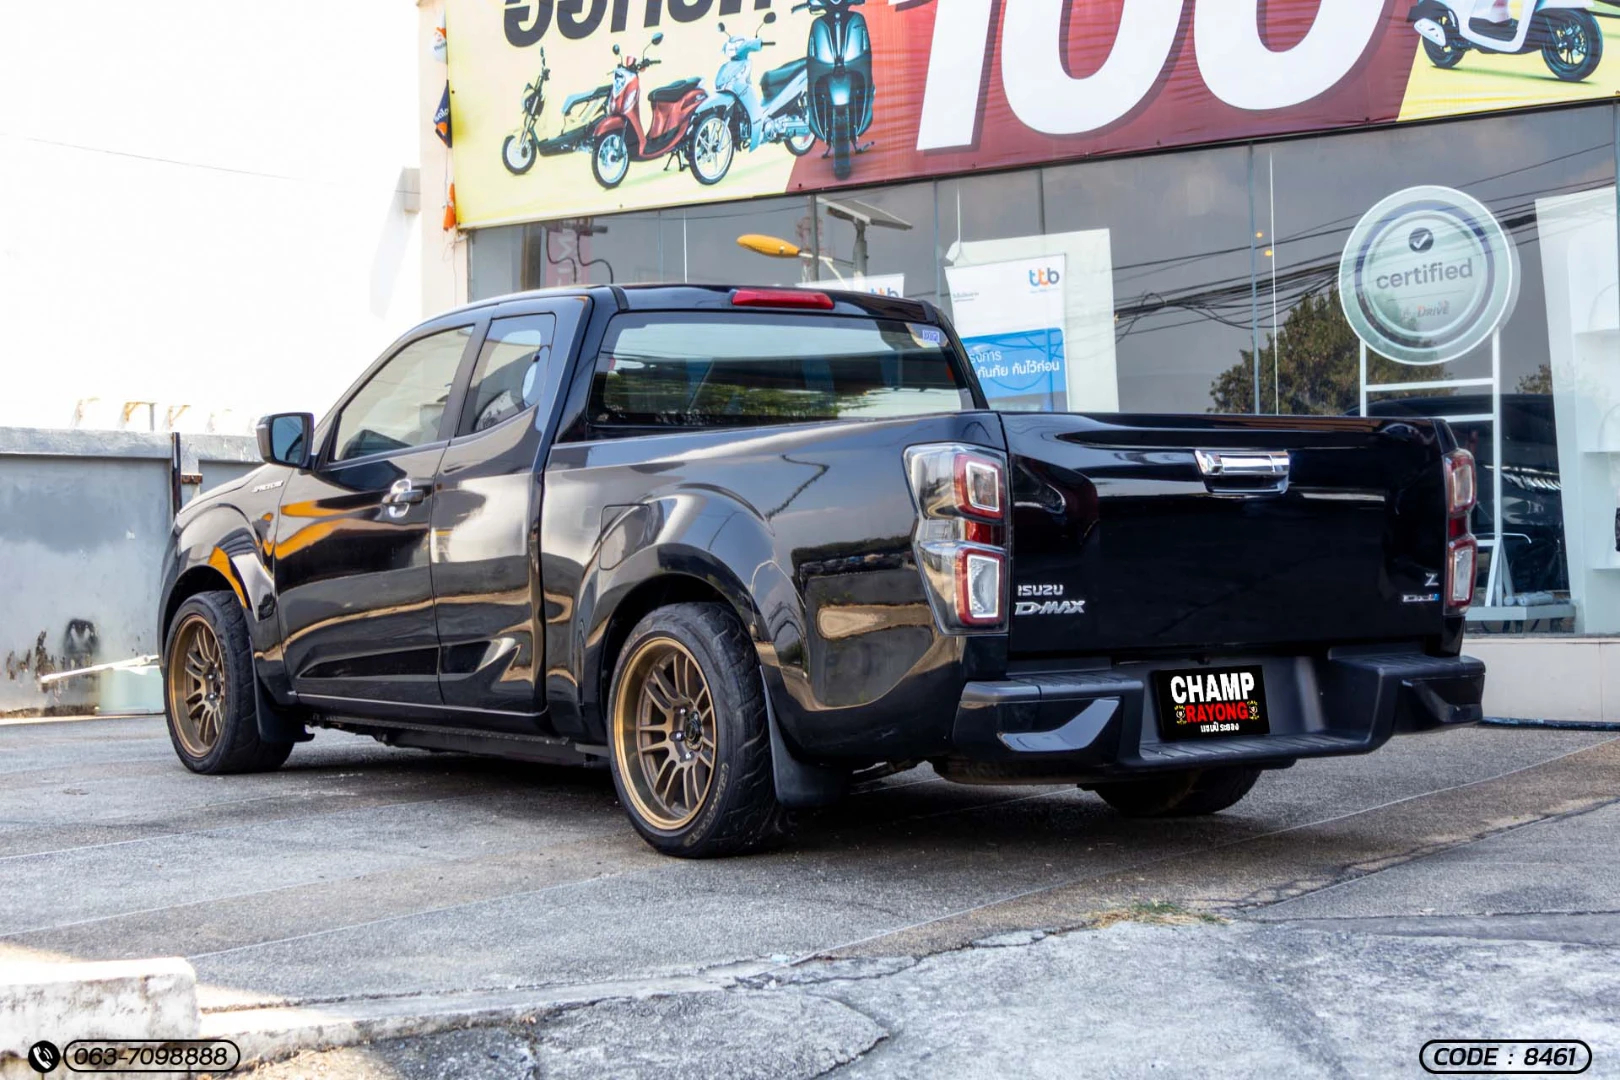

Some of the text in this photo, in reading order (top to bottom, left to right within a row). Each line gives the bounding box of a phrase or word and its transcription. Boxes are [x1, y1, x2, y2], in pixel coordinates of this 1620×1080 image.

[1029, 268, 1060, 286] ttb
[1376, 258, 1473, 289] certified
[969, 351, 1002, 364] รงการ
[1424, 572, 1439, 587] Z
[1017, 584, 1064, 597] ISUZU
[1014, 600, 1086, 616] D-MAX
